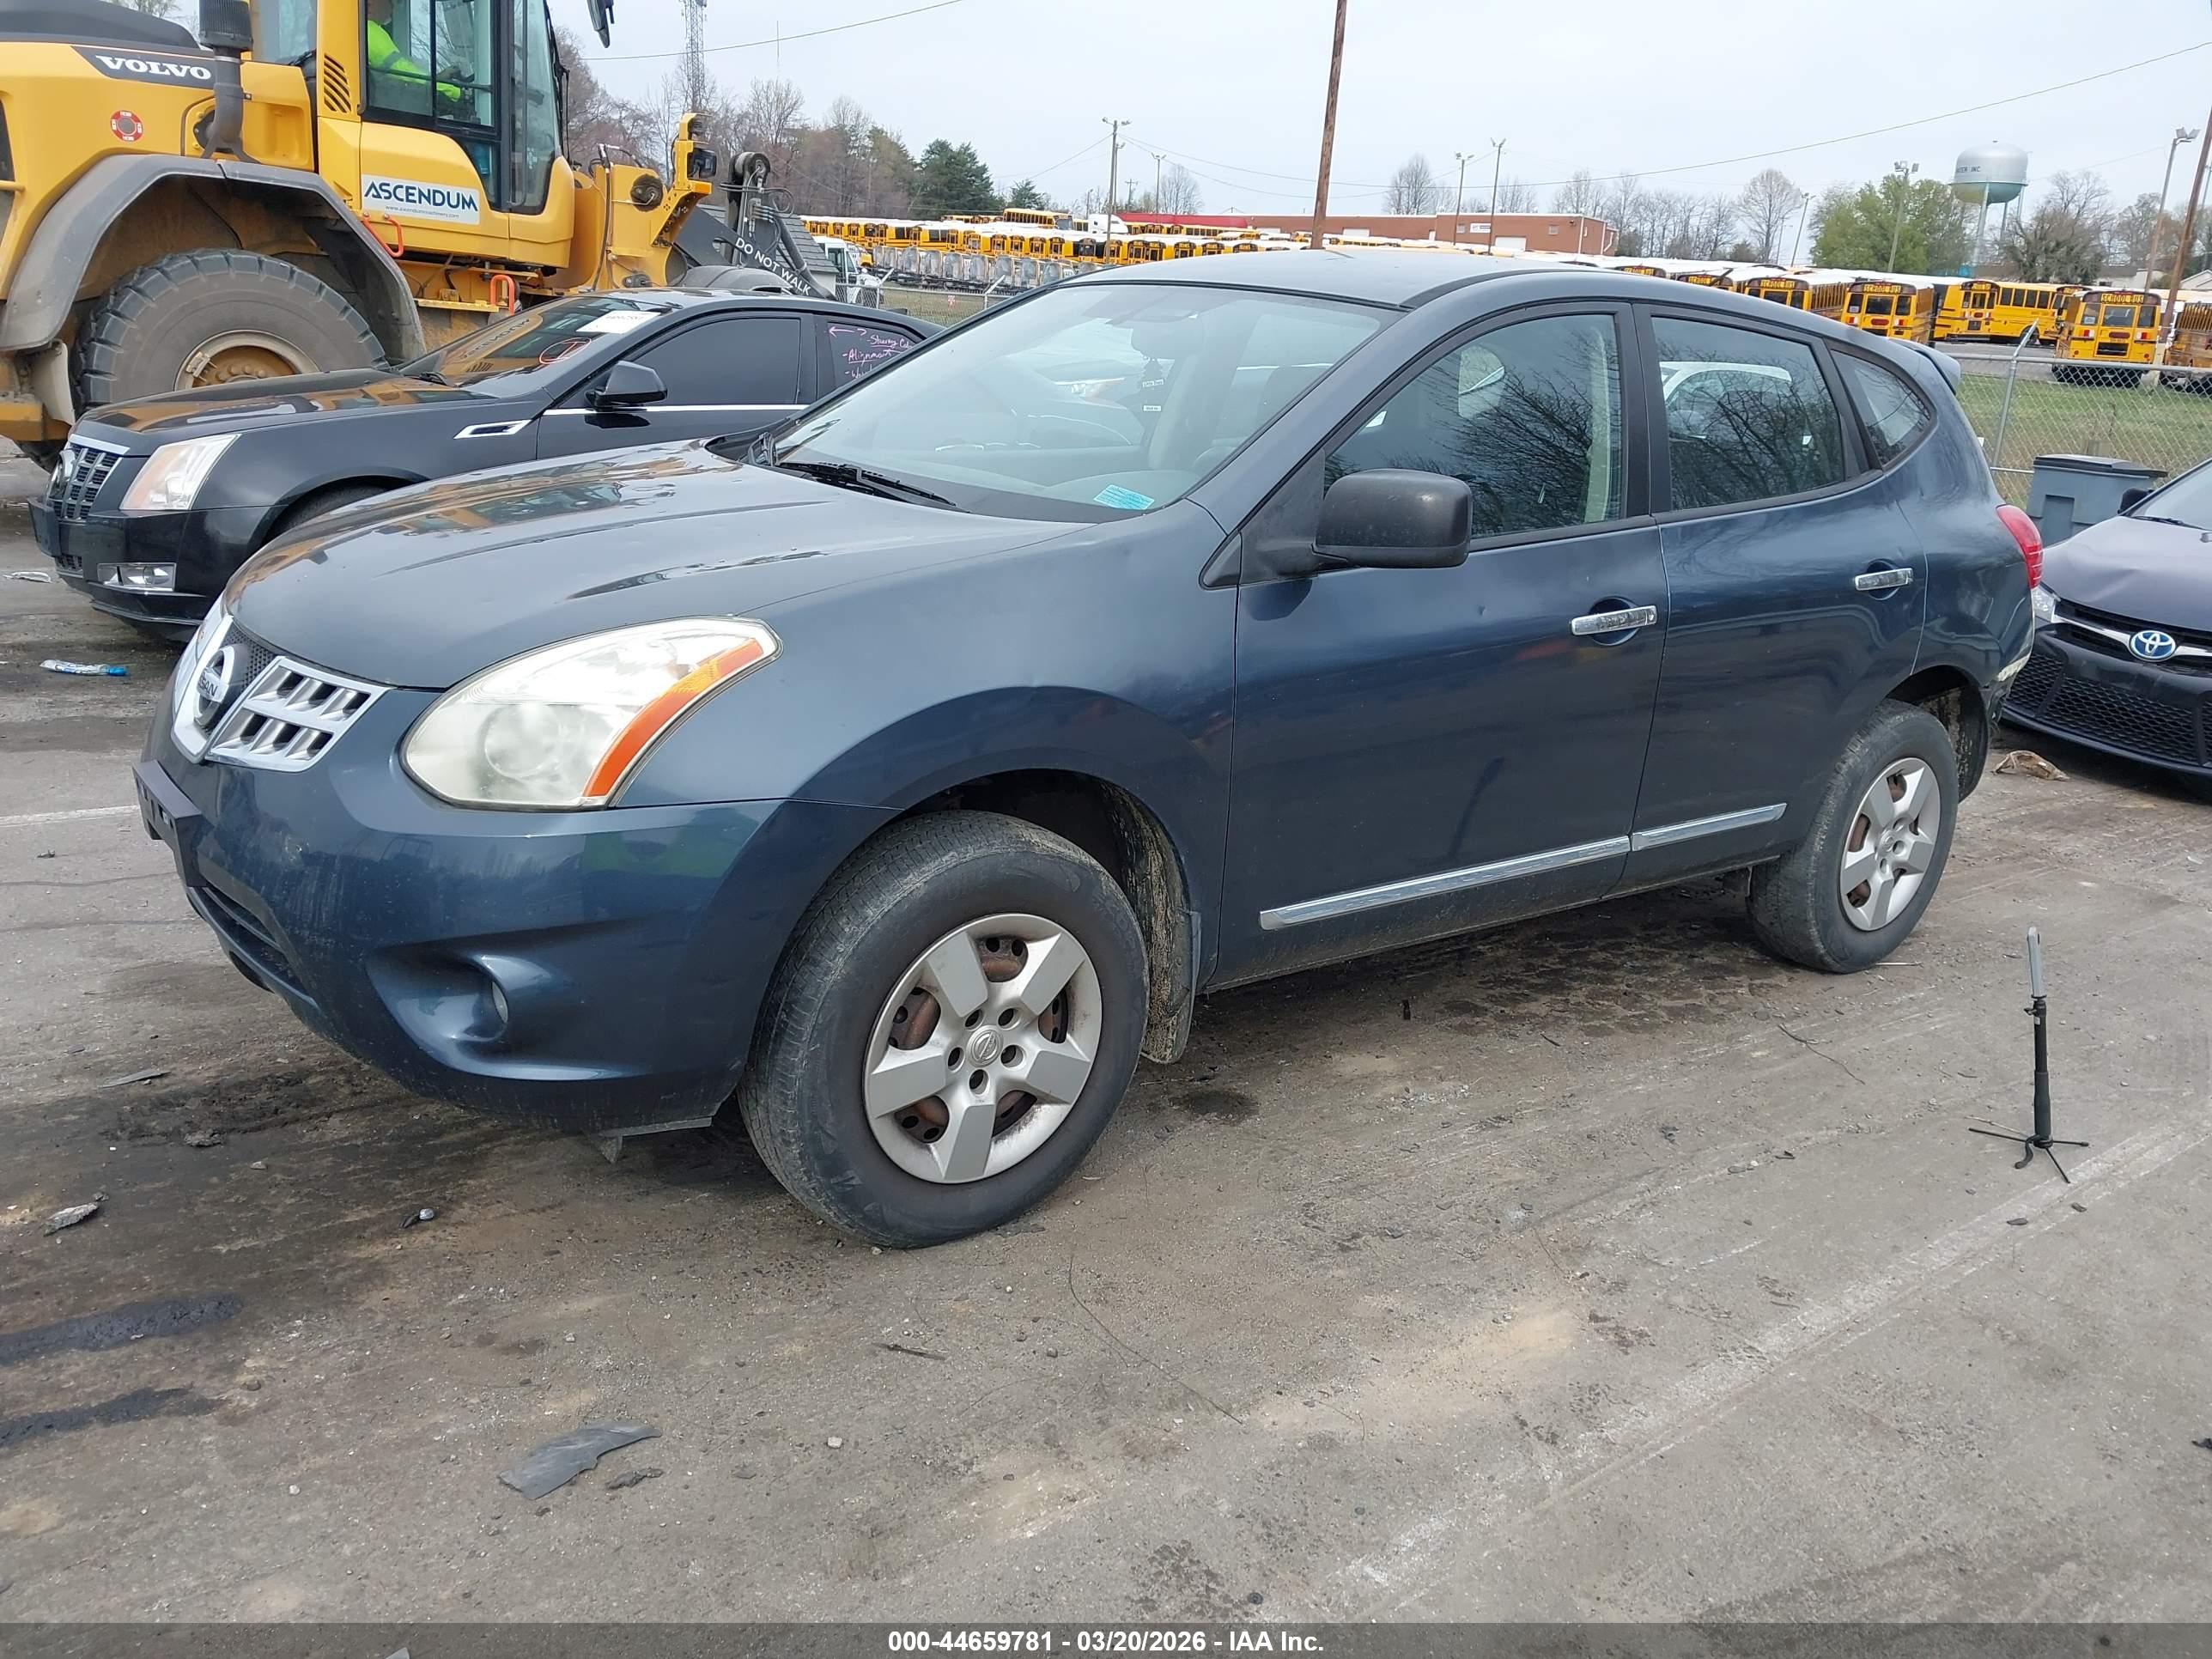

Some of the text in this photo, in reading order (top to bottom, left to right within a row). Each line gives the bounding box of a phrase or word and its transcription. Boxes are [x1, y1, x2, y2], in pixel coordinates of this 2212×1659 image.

[95, 55, 211, 80] VOLVO
[364, 181, 478, 212] ASCENDUM
[736, 238, 811, 295] DO NOT WALK
[2102, 294, 2144, 303] SCHOOL BUS
